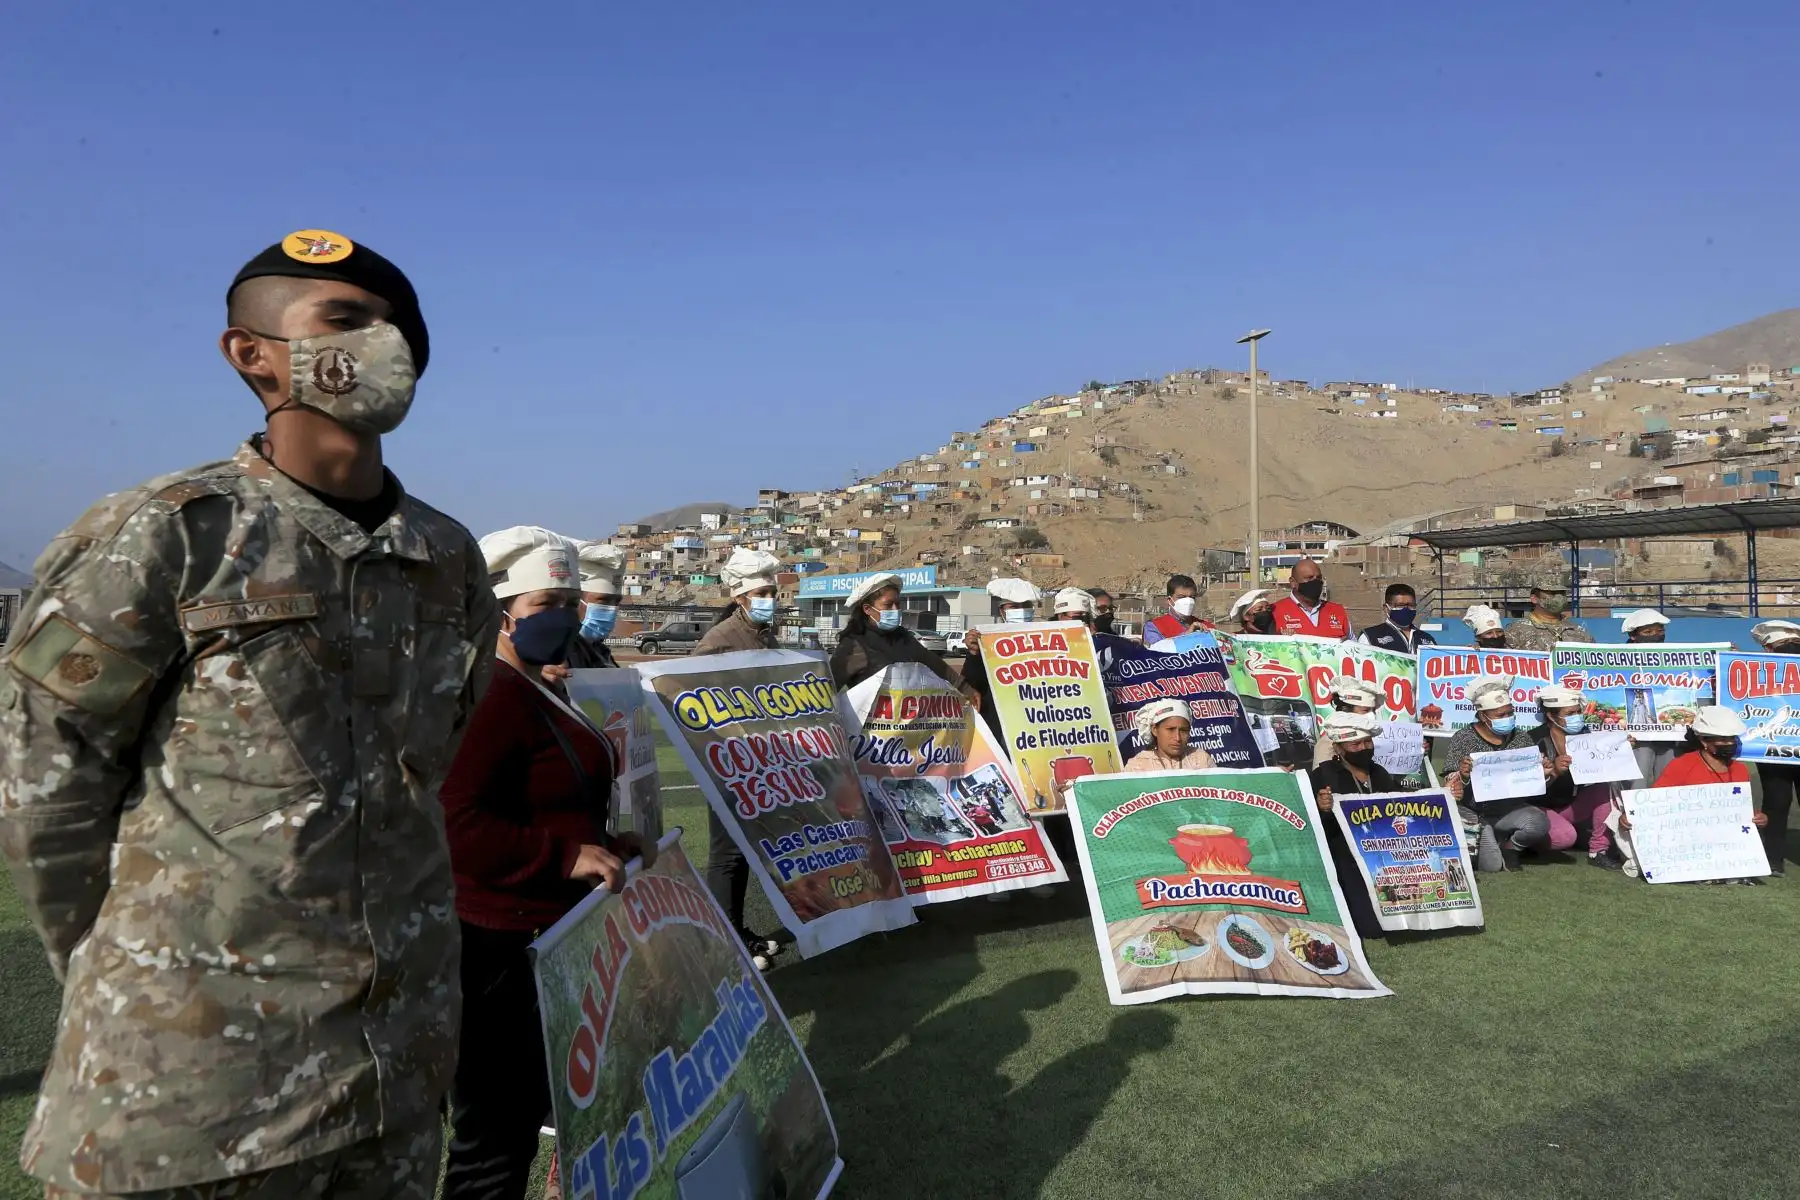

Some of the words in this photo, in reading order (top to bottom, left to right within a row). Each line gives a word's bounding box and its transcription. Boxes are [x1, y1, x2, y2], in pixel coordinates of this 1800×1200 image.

[996, 633, 1068, 657] OLLA
[996, 656, 1089, 684] COMÚN
[1119, 658, 1163, 678] OLLA
[1163, 645, 1220, 669] COMÚN
[1426, 655, 1480, 678] OLLA
[1486, 655, 1550, 680] COMÚ
[1557, 652, 1581, 665] UPIS
[1585, 651, 1604, 665] LOS
[1608, 652, 1660, 667] CLAVELES
[1664, 652, 1701, 666] PARTE
[1018, 682, 1081, 703] Mujeres
[1157, 672, 1227, 699] JUVENTUD
[1588, 674, 1627, 689] OLLA
[1631, 672, 1706, 690] COMÚN
[1729, 660, 1800, 700] OLLA
[676, 686, 762, 730] OLLA
[756, 674, 835, 717] COMÚ
[901, 692, 963, 719] COMÚN
[1025, 704, 1092, 723] Valiosas
[1739, 705, 1772, 719] San
[1016, 731, 1036, 750] de
[1039, 725, 1109, 747] Filadelfia
[1206, 724, 1232, 737] signo
[708, 727, 838, 779] CORAZON
[850, 734, 913, 765] Villa
[917, 736, 968, 773] Jesús
[728, 767, 825, 816] JESUS
[1093, 806, 1124, 838] OLLA
[1118, 792, 1160, 817] COMÚN
[1155, 787, 1219, 806] MIRADOR
[1218, 789, 1246, 802] LOS
[1245, 794, 1305, 830] ANGELES
[1351, 805, 1383, 824] OLLA
[1385, 801, 1443, 819] COMÚN
[761, 834, 804, 859] Las
[1362, 839, 1379, 852] SAN
[1379, 838, 1409, 851] MARTIN
[1410, 837, 1423, 848] DE
[1424, 835, 1453, 847] PORRES
[921, 874, 941, 885] Villa
[942, 869, 978, 882] hermosa
[990, 866, 1007, 877] 921
[1028, 860, 1046, 871] 348
[829, 869, 863, 898] José
[1147, 878, 1303, 907] Pachacamac
[1447, 900, 1473, 908] VIERNES
[567, 911, 630, 1101] OLLA
